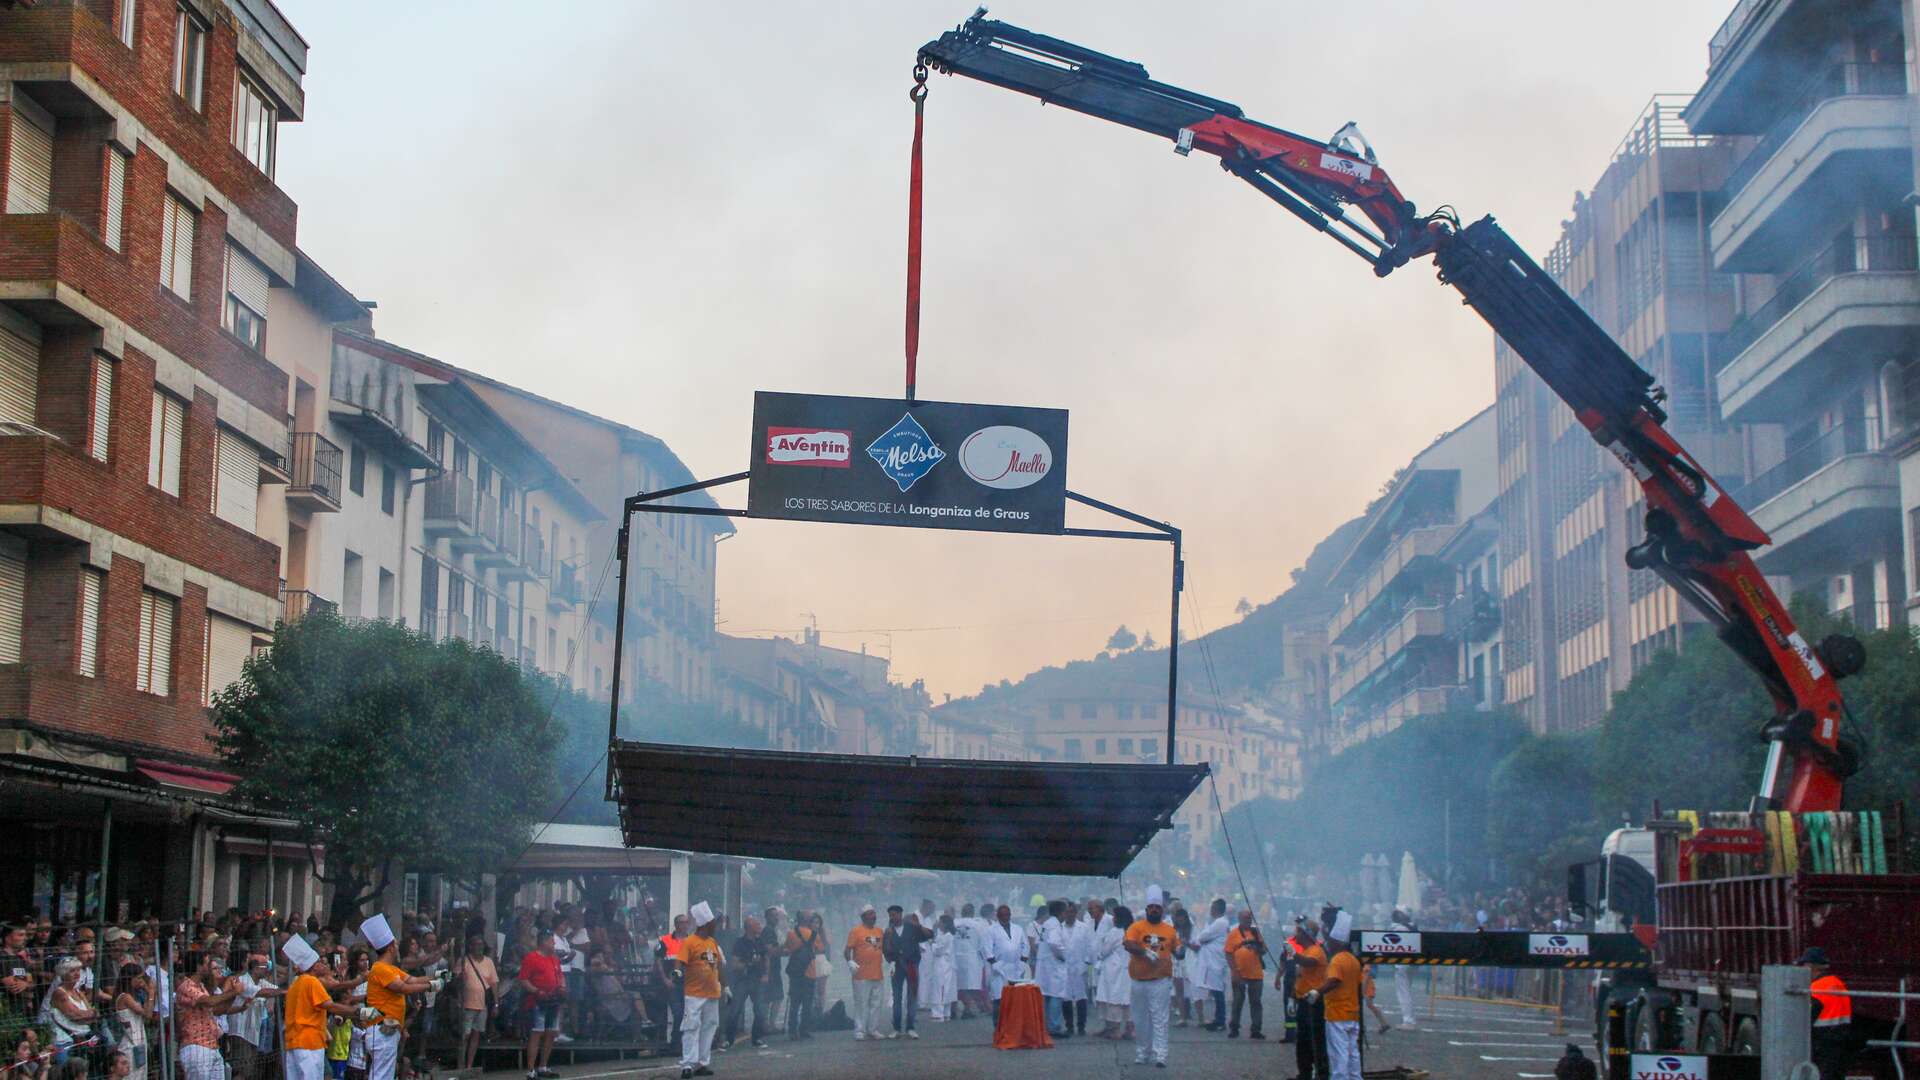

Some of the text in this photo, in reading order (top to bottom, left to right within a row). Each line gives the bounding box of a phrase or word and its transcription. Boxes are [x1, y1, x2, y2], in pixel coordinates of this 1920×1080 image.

[778, 437, 845, 456] Aventín
[880, 442, 943, 470] Melsa
[1007, 450, 1046, 473] Maella
[785, 497, 1030, 520] LOS TRES SABORES DE LA Longaniza de Graus
[1366, 944, 1416, 952] VIDAL
[1534, 946, 1585, 955] VIDAL
[1637, 1071, 1703, 1080] VIDAL
